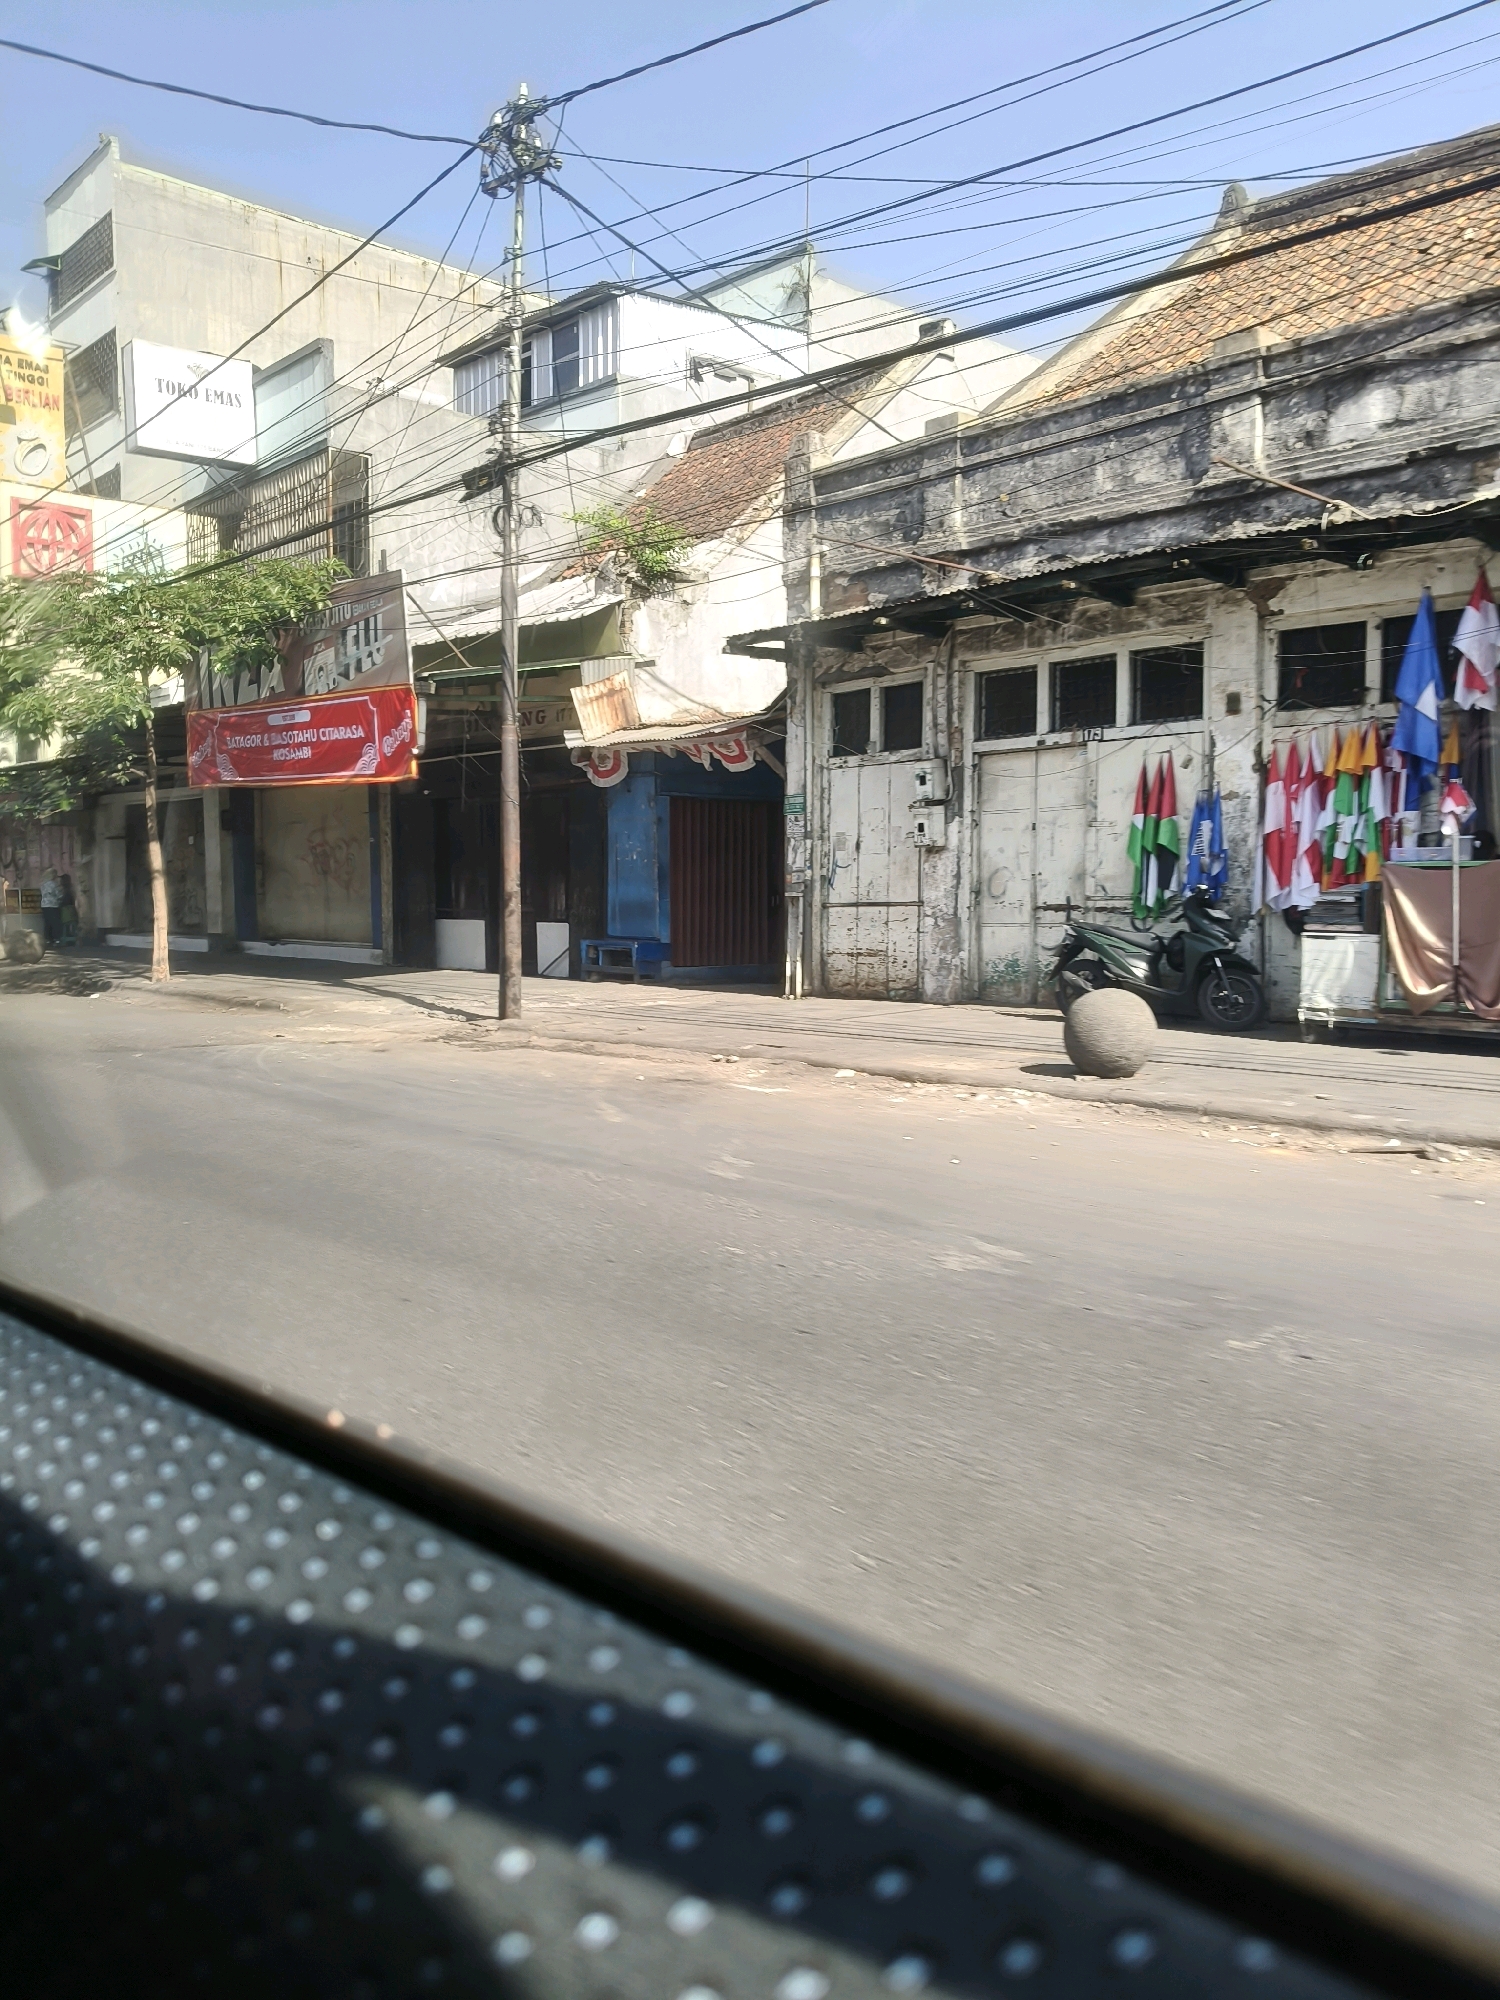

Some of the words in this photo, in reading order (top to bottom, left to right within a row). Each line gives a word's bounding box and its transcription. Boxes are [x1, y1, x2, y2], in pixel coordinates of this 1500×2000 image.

[17, 357, 50, 375] EMAS
[4, 383, 60, 412] BERLIAN
[154, 377, 199, 400] TOKO
[205, 387, 242, 408] EMAS
[331, 600, 352, 627] JITU
[226, 734, 262, 749] BATAGOR
[263, 733, 269, 746] &
[270, 728, 318, 746] BASOTAHU
[319, 724, 365, 741] CITARASA
[272, 746, 312, 761] KOSAMBI
